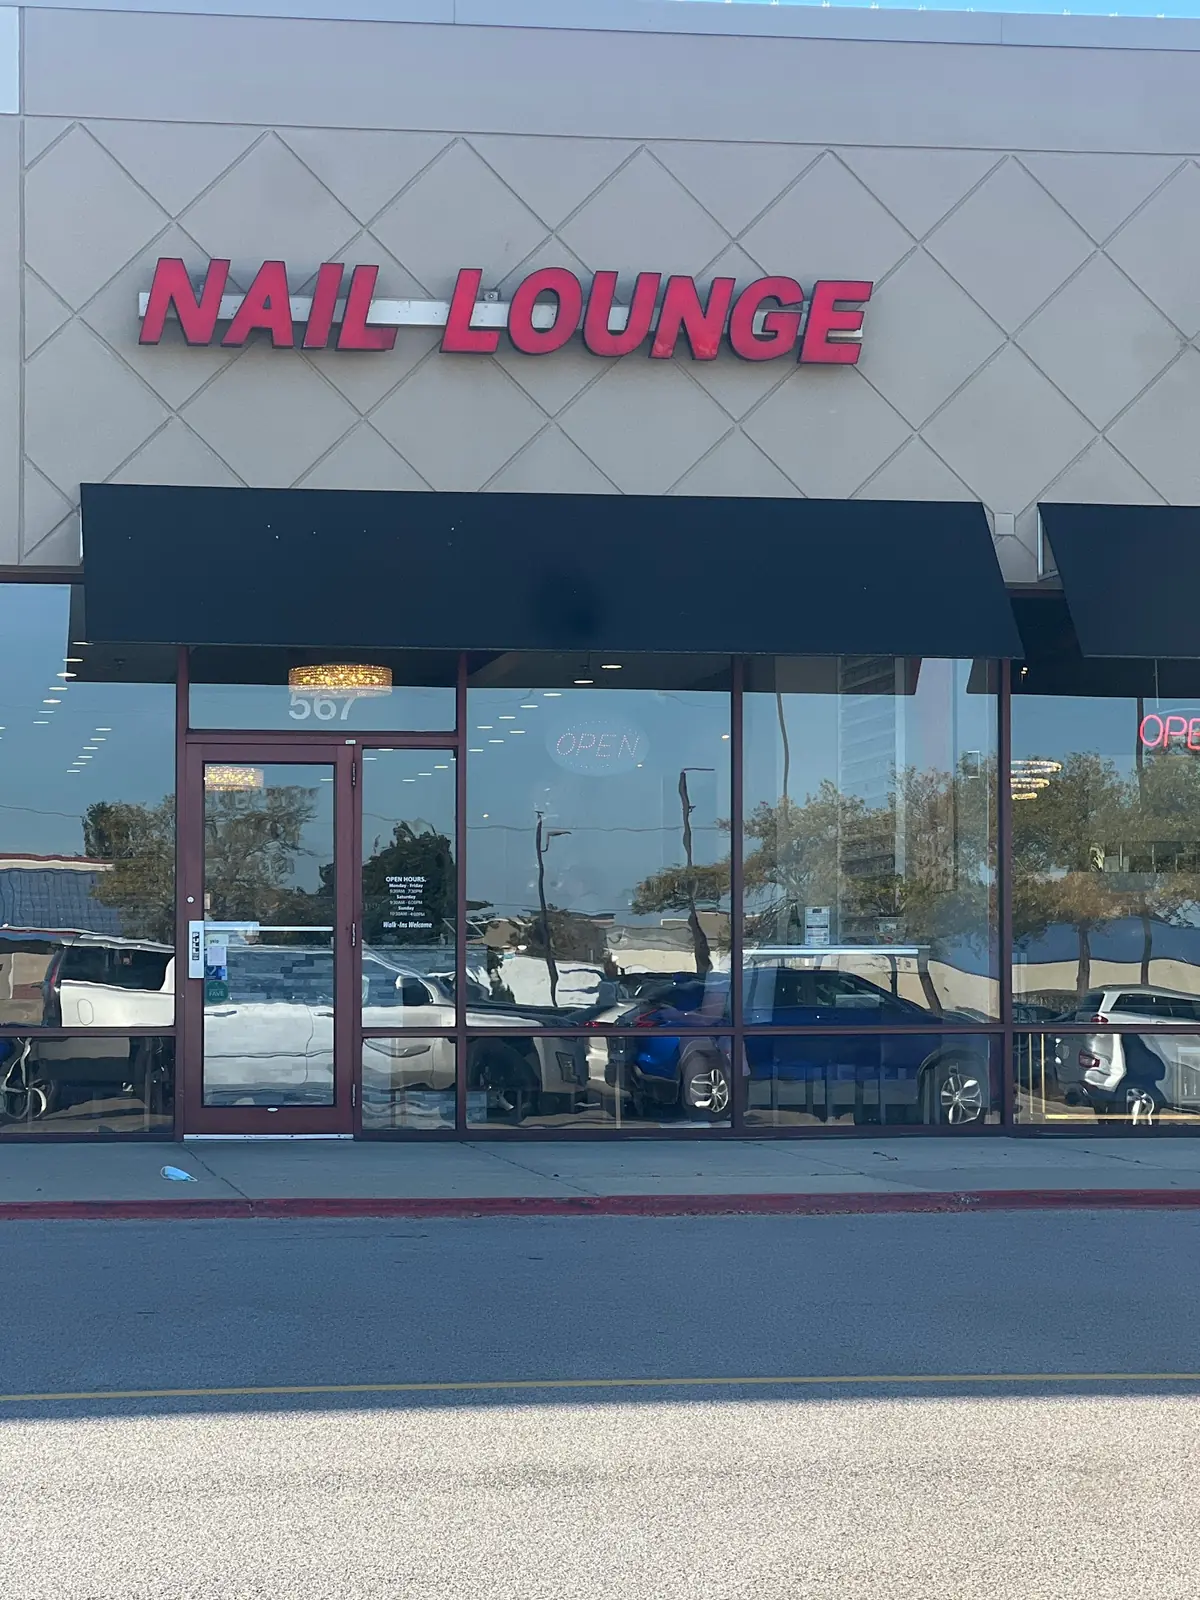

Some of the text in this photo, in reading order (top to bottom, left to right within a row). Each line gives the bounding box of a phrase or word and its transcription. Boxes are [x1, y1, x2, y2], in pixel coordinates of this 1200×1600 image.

[138, 257, 874, 365] NAIL LOUNGE
[288, 692, 356, 720] 567
[556, 732, 640, 759] OPEN
